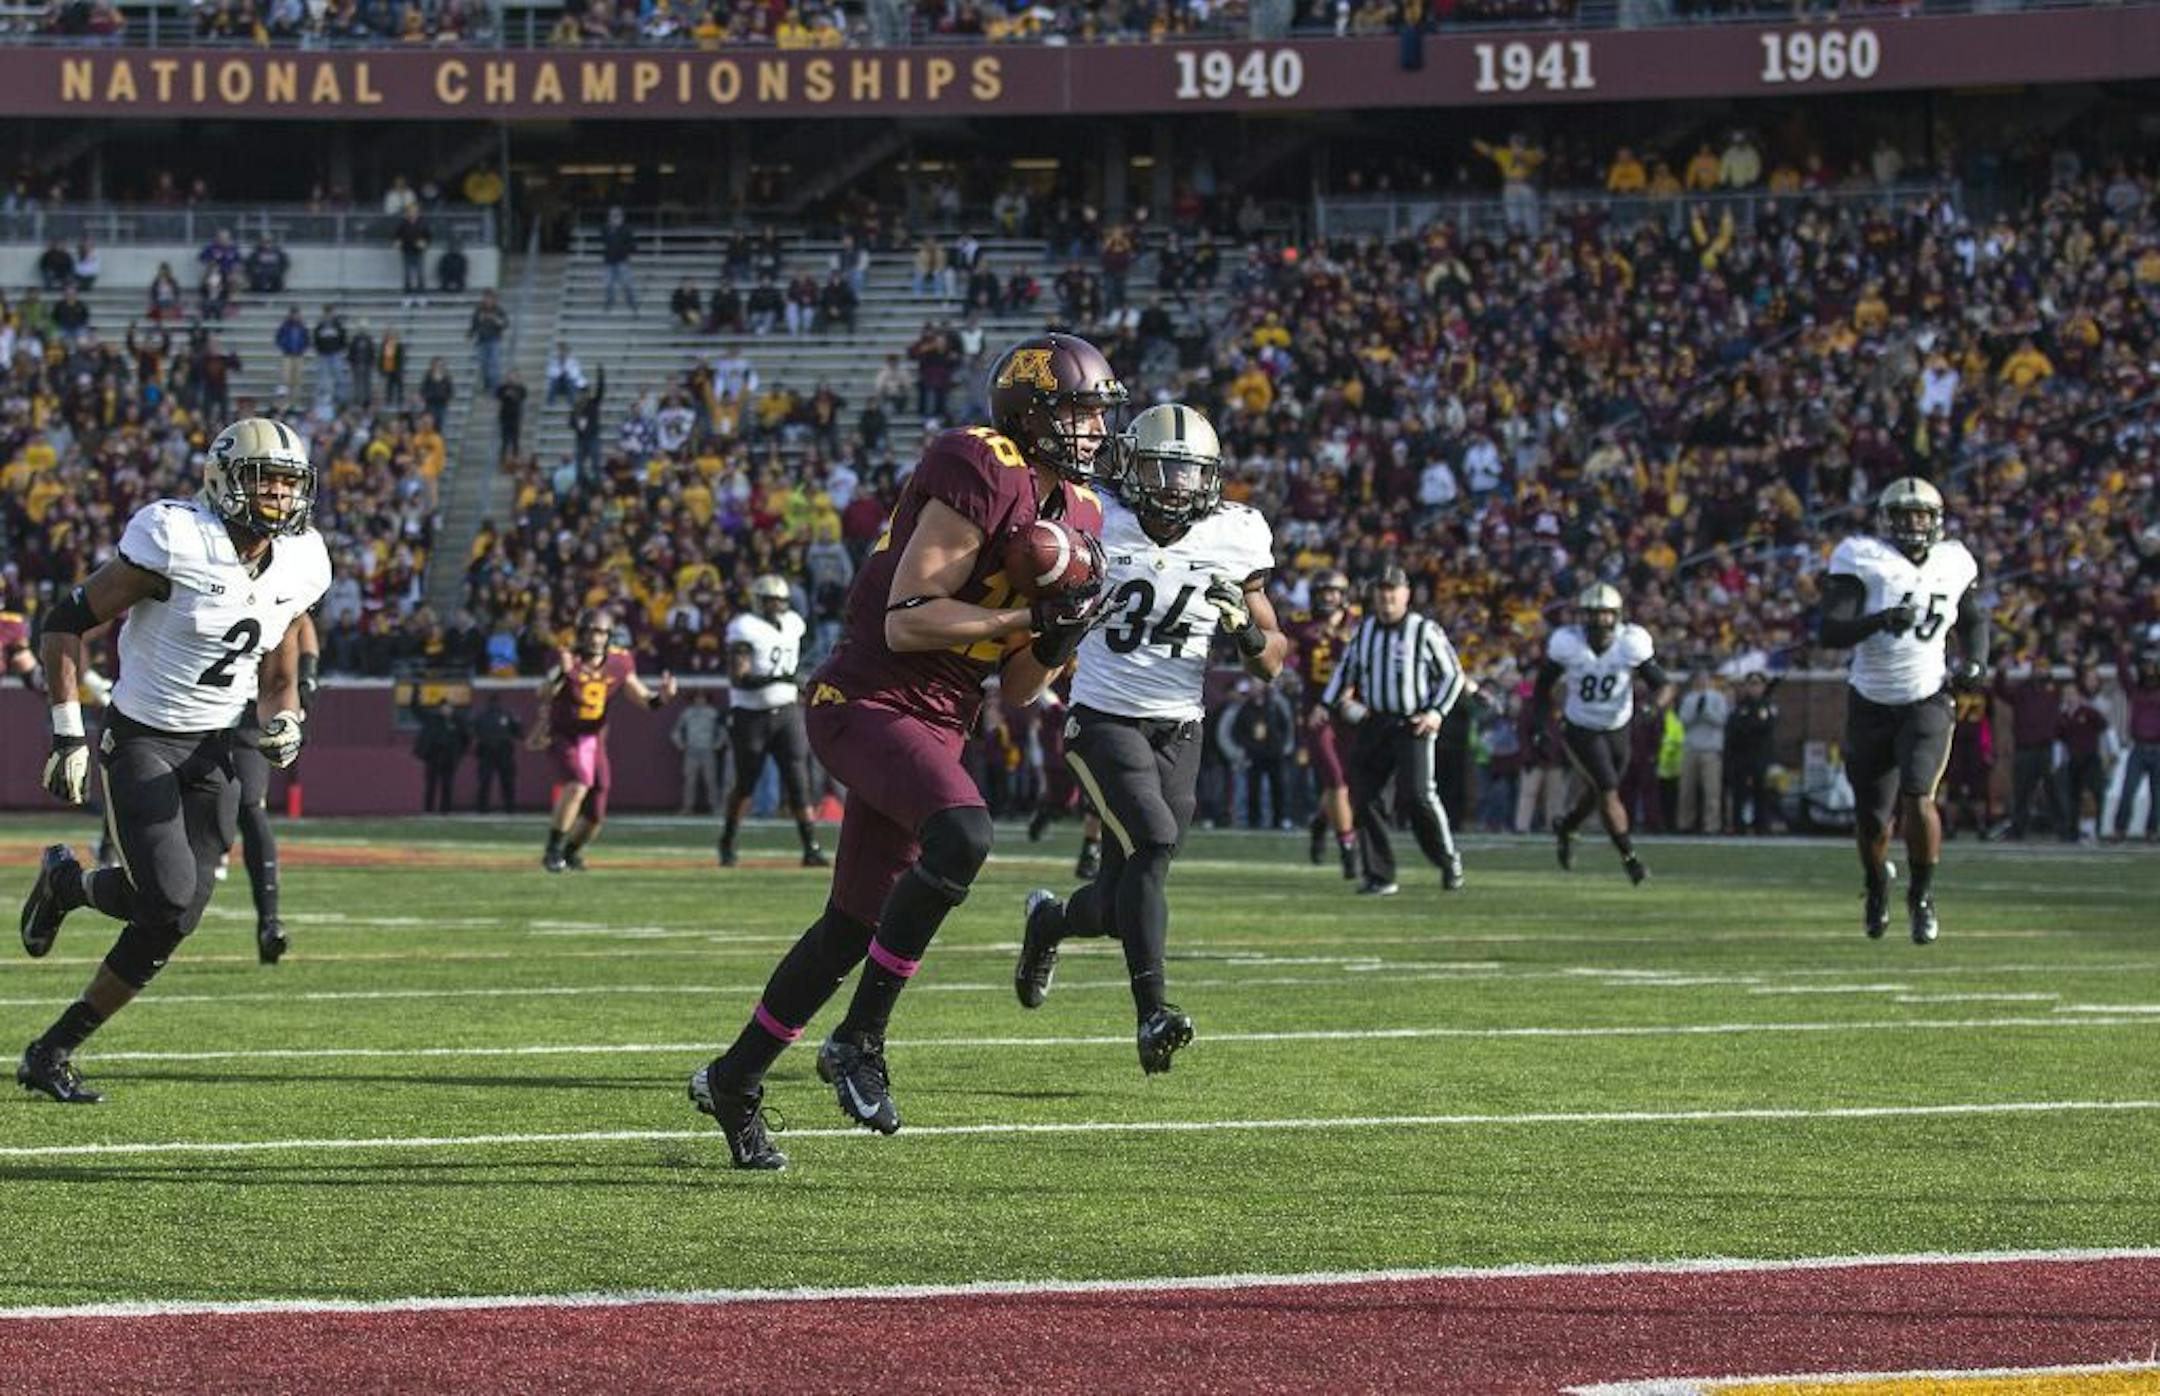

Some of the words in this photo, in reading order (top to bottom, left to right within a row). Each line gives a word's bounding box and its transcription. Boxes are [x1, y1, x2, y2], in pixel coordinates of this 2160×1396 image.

[61, 59, 382, 104] NATIONAL
[435, 56, 1004, 104] CHAMPIONSHIPS
[1175, 48, 1304, 99] 1940
[1474, 40, 1596, 92] 1941
[1760, 28, 1880, 82] 1960
[1105, 579, 1197, 658] 34
[196, 618, 262, 687] 2
[578, 681, 609, 721] 9
[1580, 673, 1617, 703] 89
